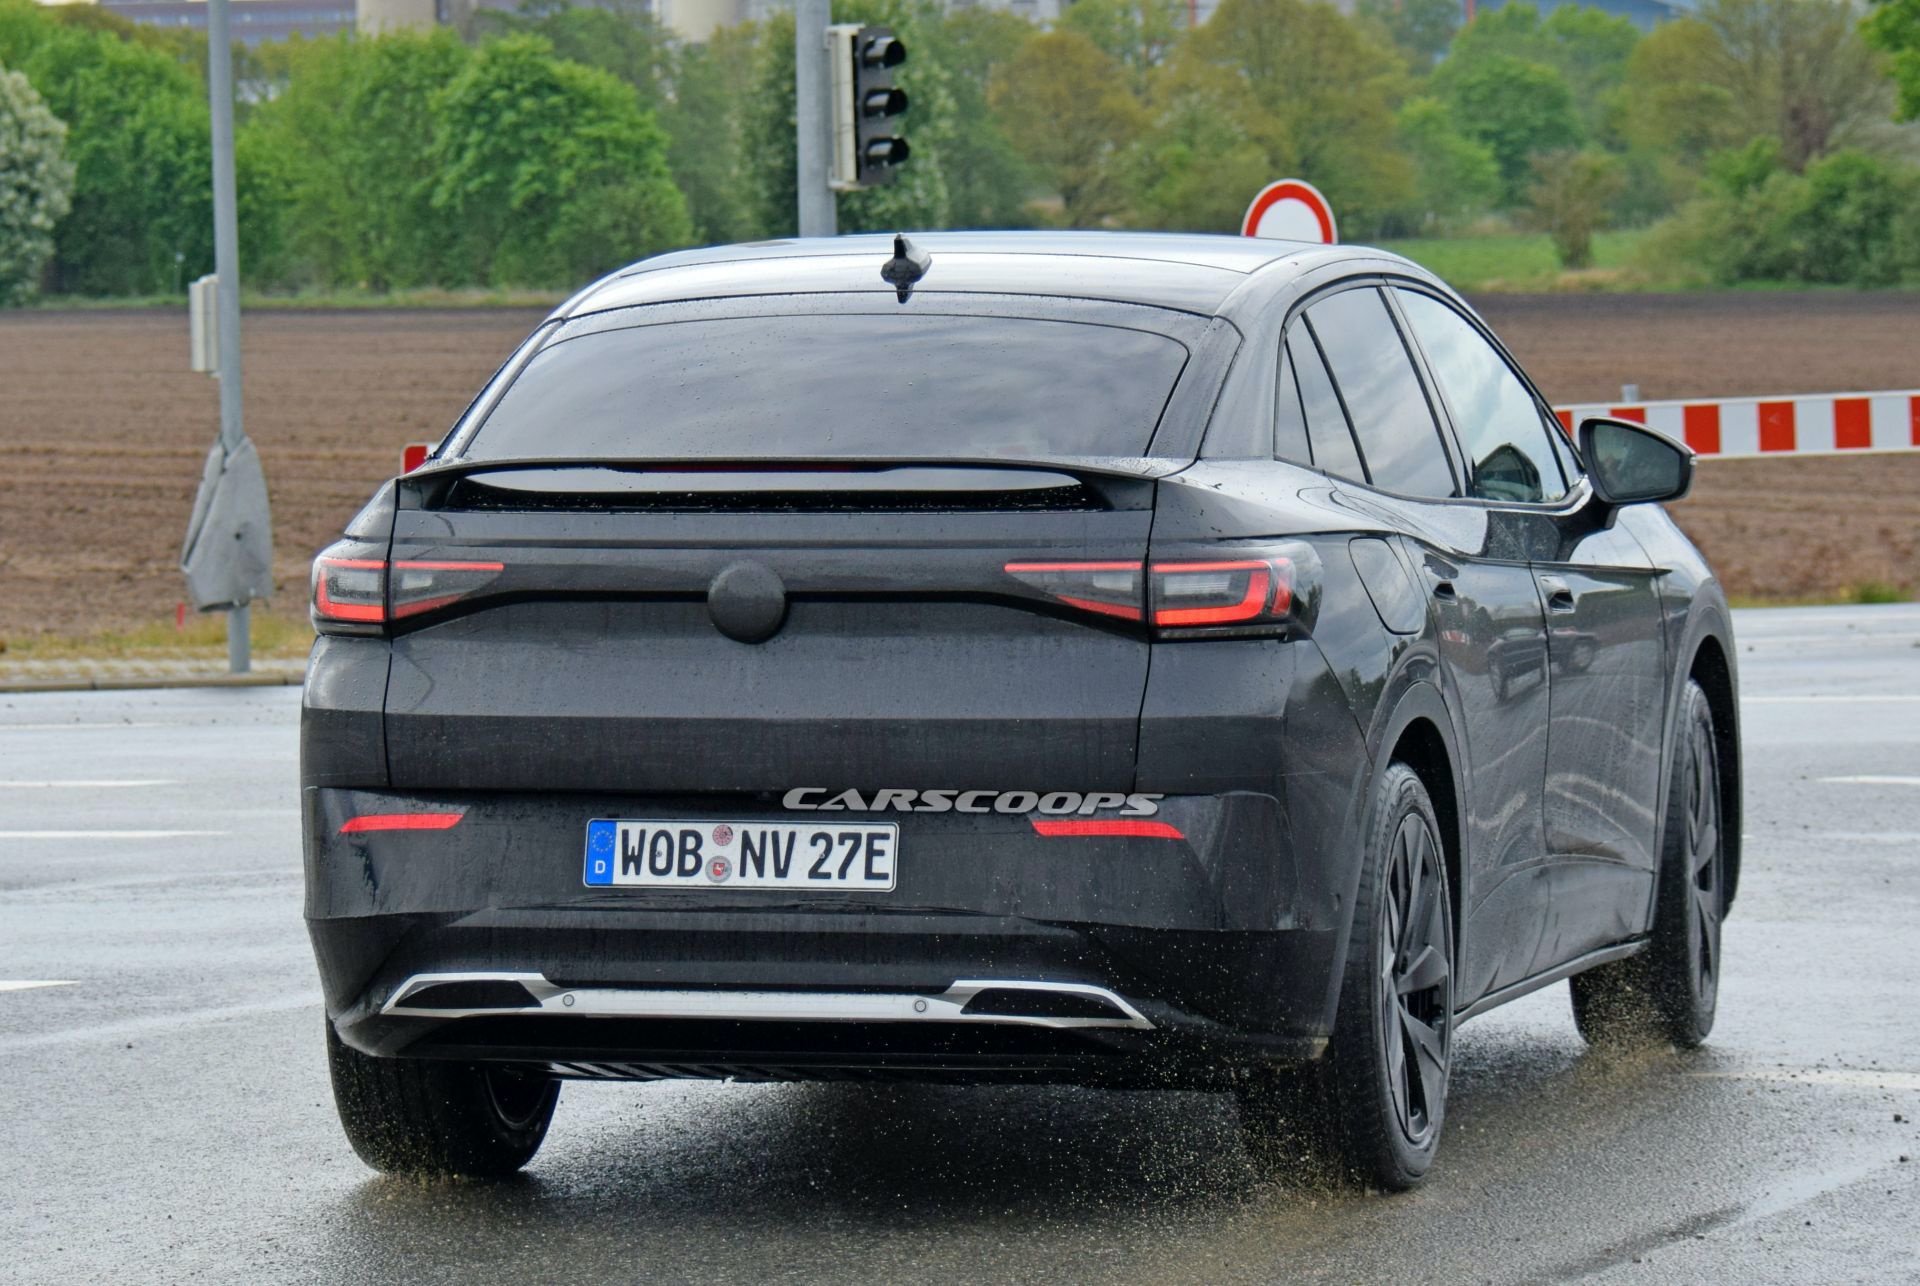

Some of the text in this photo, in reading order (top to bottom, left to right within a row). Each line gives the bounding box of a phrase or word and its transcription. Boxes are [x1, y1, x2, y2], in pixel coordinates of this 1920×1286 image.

[594, 860, 606, 874] D
[621, 828, 891, 880] WOB NV 27E
